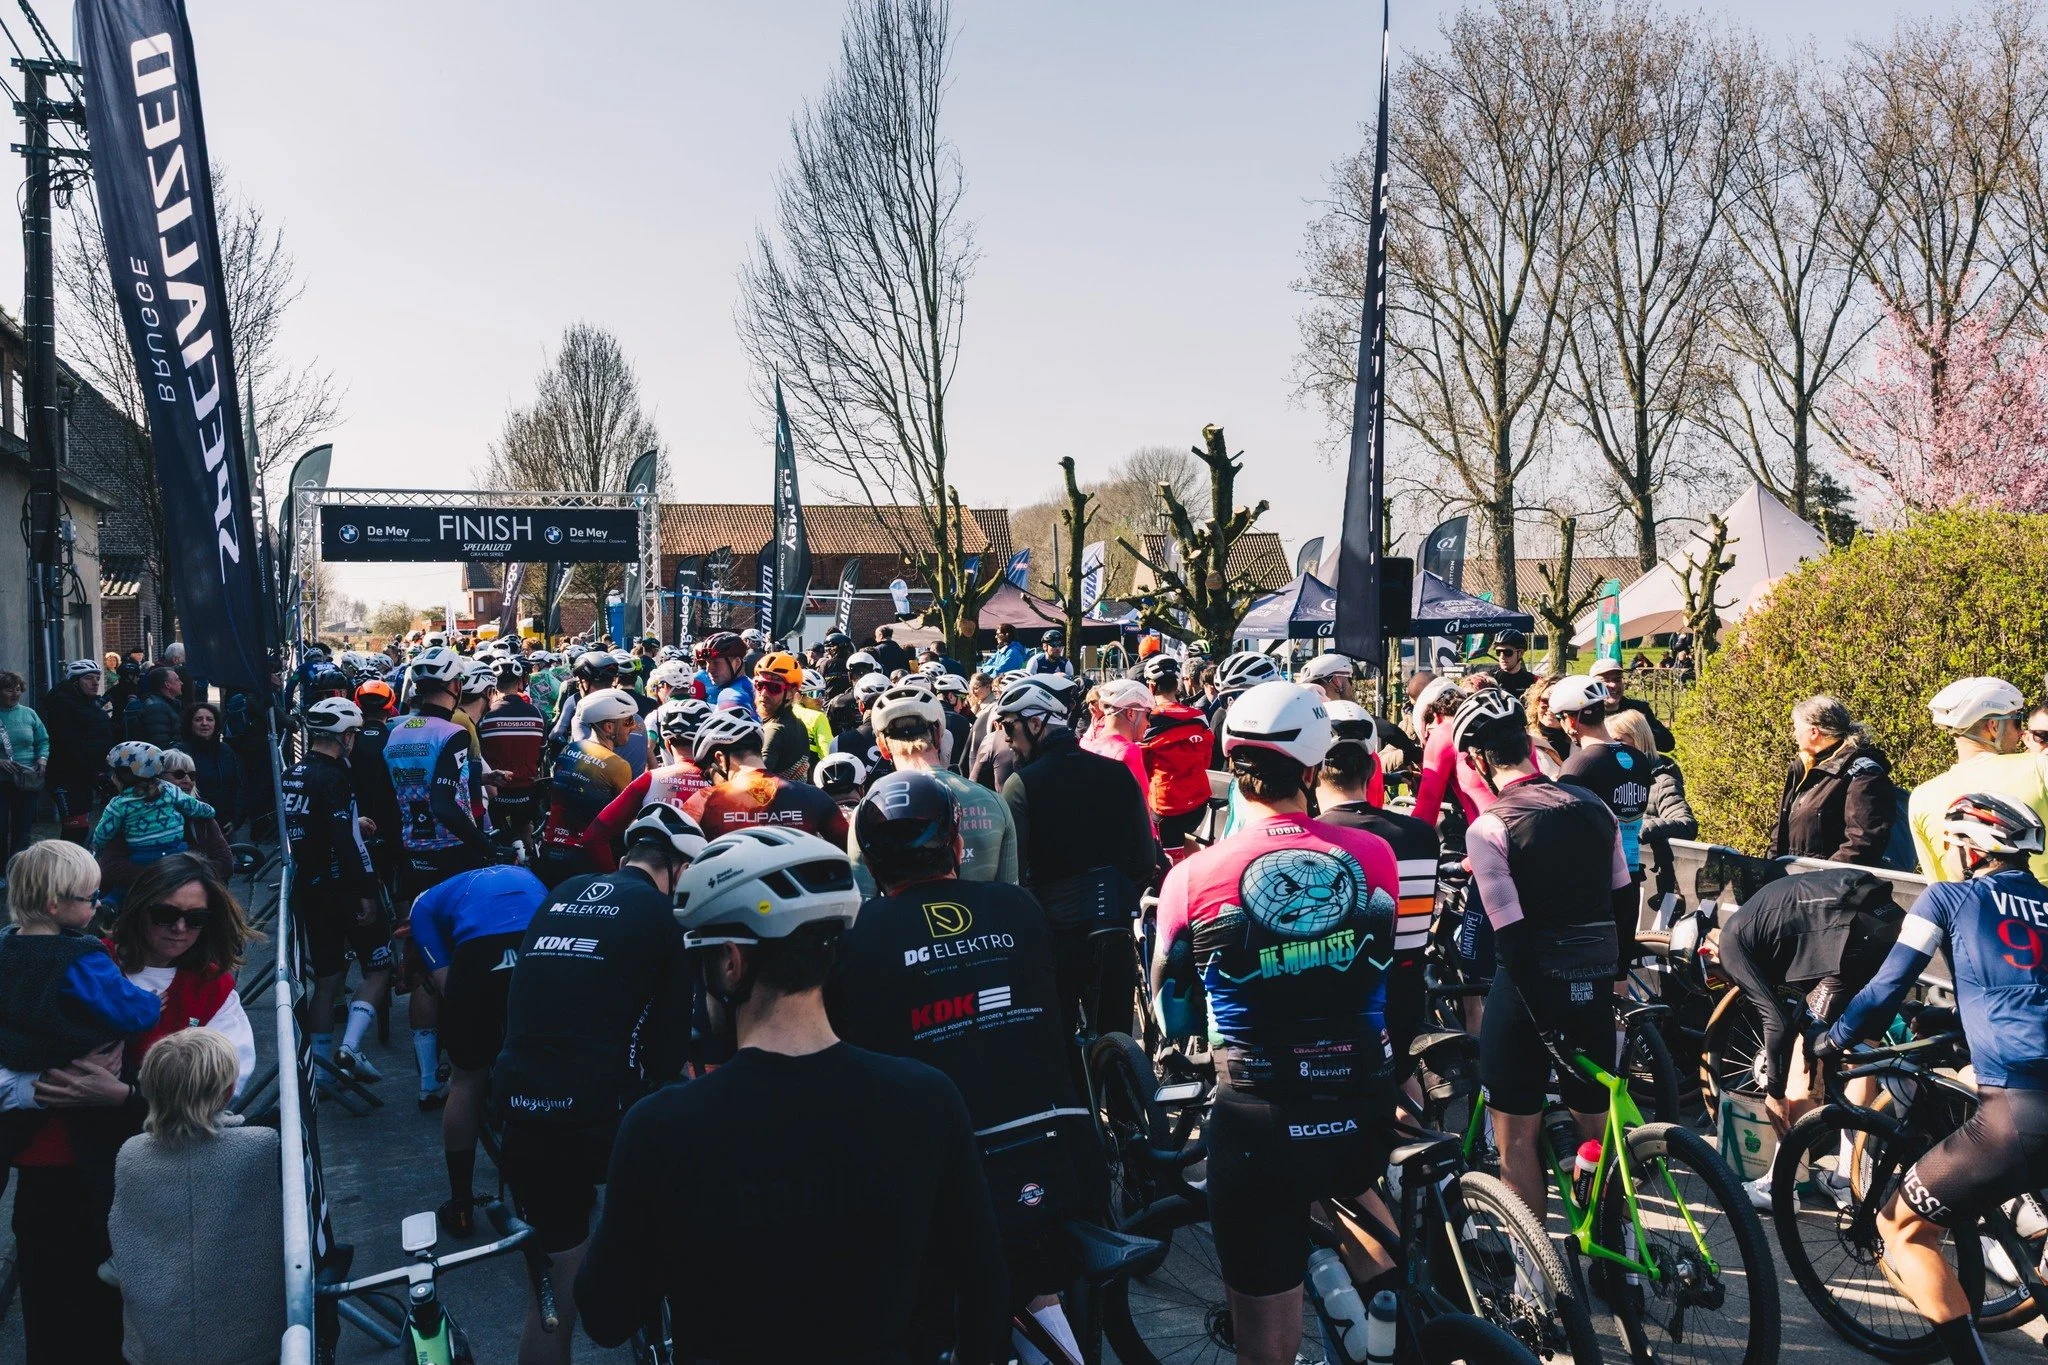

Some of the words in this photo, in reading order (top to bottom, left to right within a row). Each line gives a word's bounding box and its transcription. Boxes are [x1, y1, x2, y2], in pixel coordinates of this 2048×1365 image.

[367, 526, 383, 536] De
[385, 526, 410, 537] Mey
[439, 515, 532, 541] FINISH
[570, 527, 584, 537] De
[586, 528, 608, 539] Mey
[785, 504, 797, 551] Mey
[462, 543, 512, 551] SPECIALIZED
[680, 586, 692, 648] rgosleep
[660, 777, 686, 785] GARAGE
[495, 796, 530, 804] STADSBADER
[1613, 781, 1647, 806] COUREUR
[282, 792, 310, 815] EAL
[723, 811, 803, 823] SOUPAPE
[962, 806, 987, 816] ERIJ
[550, 903, 568, 912] DG
[566, 904, 620, 915] ELEKTRO
[533, 936, 576, 951] KDK
[904, 946, 930, 967] DG
[933, 933, 1015, 959] ELEKTRO
[1259, 945, 1281, 979] DE
[1571, 982, 1593, 992] BELGIAN
[1571, 991, 1594, 1001] CYCLING
[911, 993, 975, 1031] KDK
[947, 1019, 973, 1030] POORTEN
[976, 1012, 1004, 1022] MOTOREN
[1312, 1068, 1352, 1077] DEPART
[1289, 1119, 1358, 1137] BOCCA
